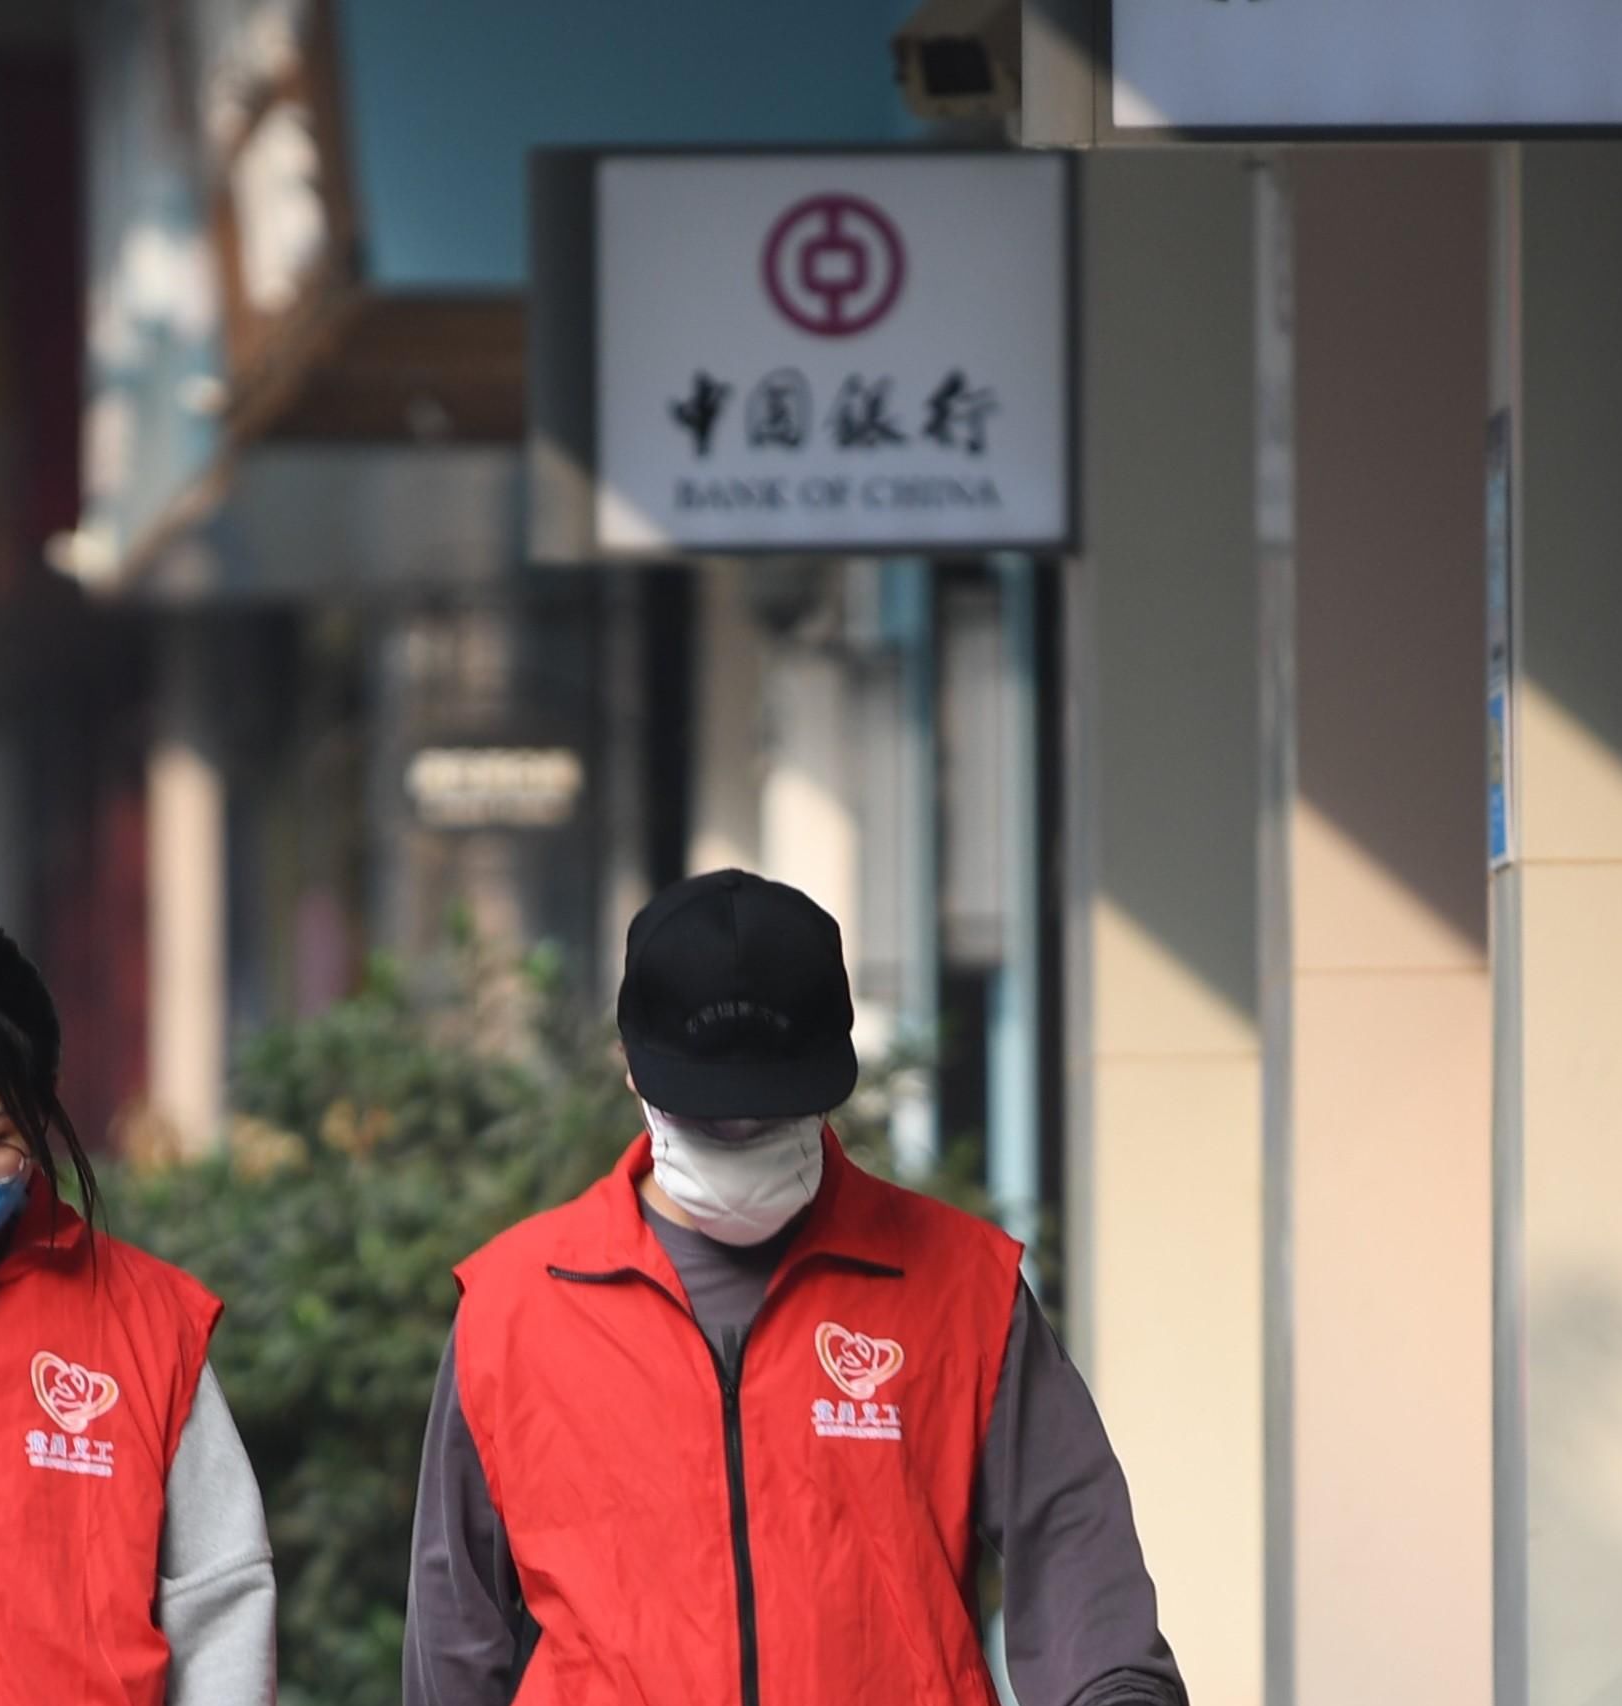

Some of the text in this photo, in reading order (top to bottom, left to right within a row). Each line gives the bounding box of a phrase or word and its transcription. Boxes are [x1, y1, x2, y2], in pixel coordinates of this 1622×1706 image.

[668, 367, 999, 458] 中国银行
[675, 476, 1004, 509] BANK OF CHINA
